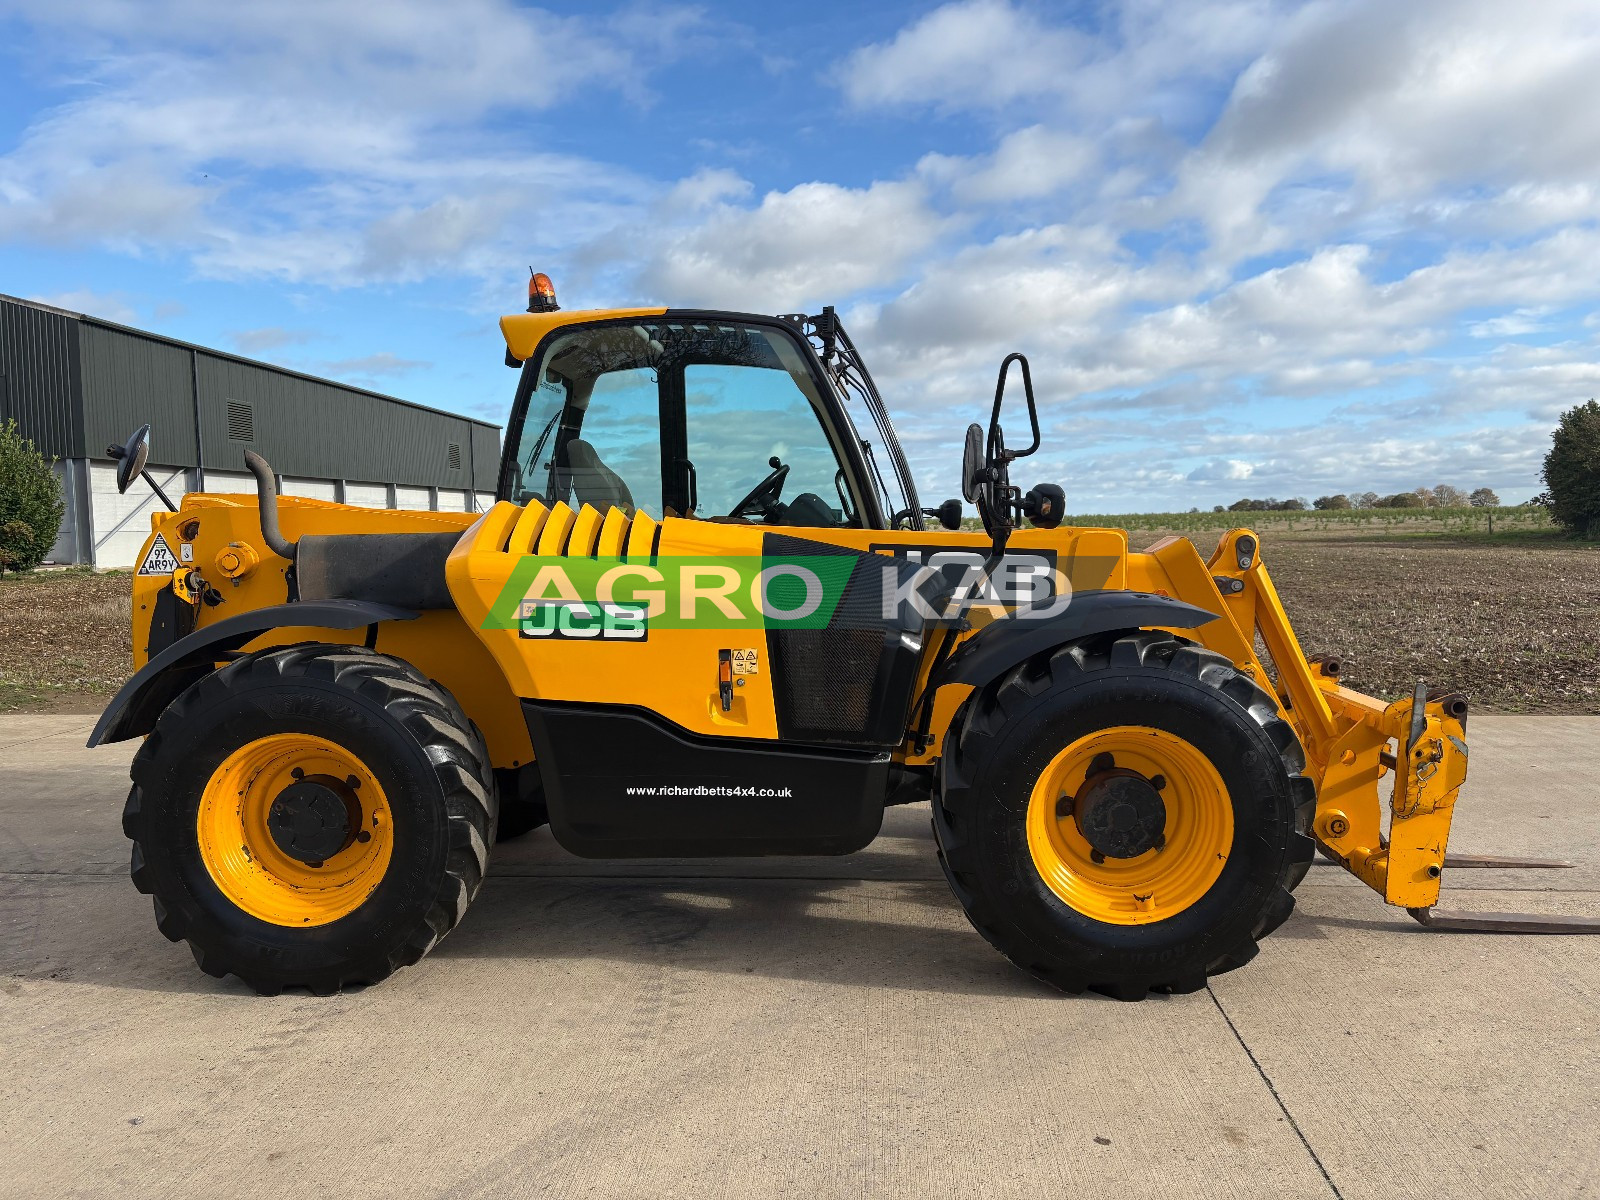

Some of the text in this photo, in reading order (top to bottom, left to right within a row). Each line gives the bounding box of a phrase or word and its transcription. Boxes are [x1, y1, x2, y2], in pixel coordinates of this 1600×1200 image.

[154, 549, 166, 559] 97
[149, 560, 174, 570] AR9Y
[522, 602, 647, 638] JCB
[626, 785, 793, 798] www.richardbetts4x4.co.uk
